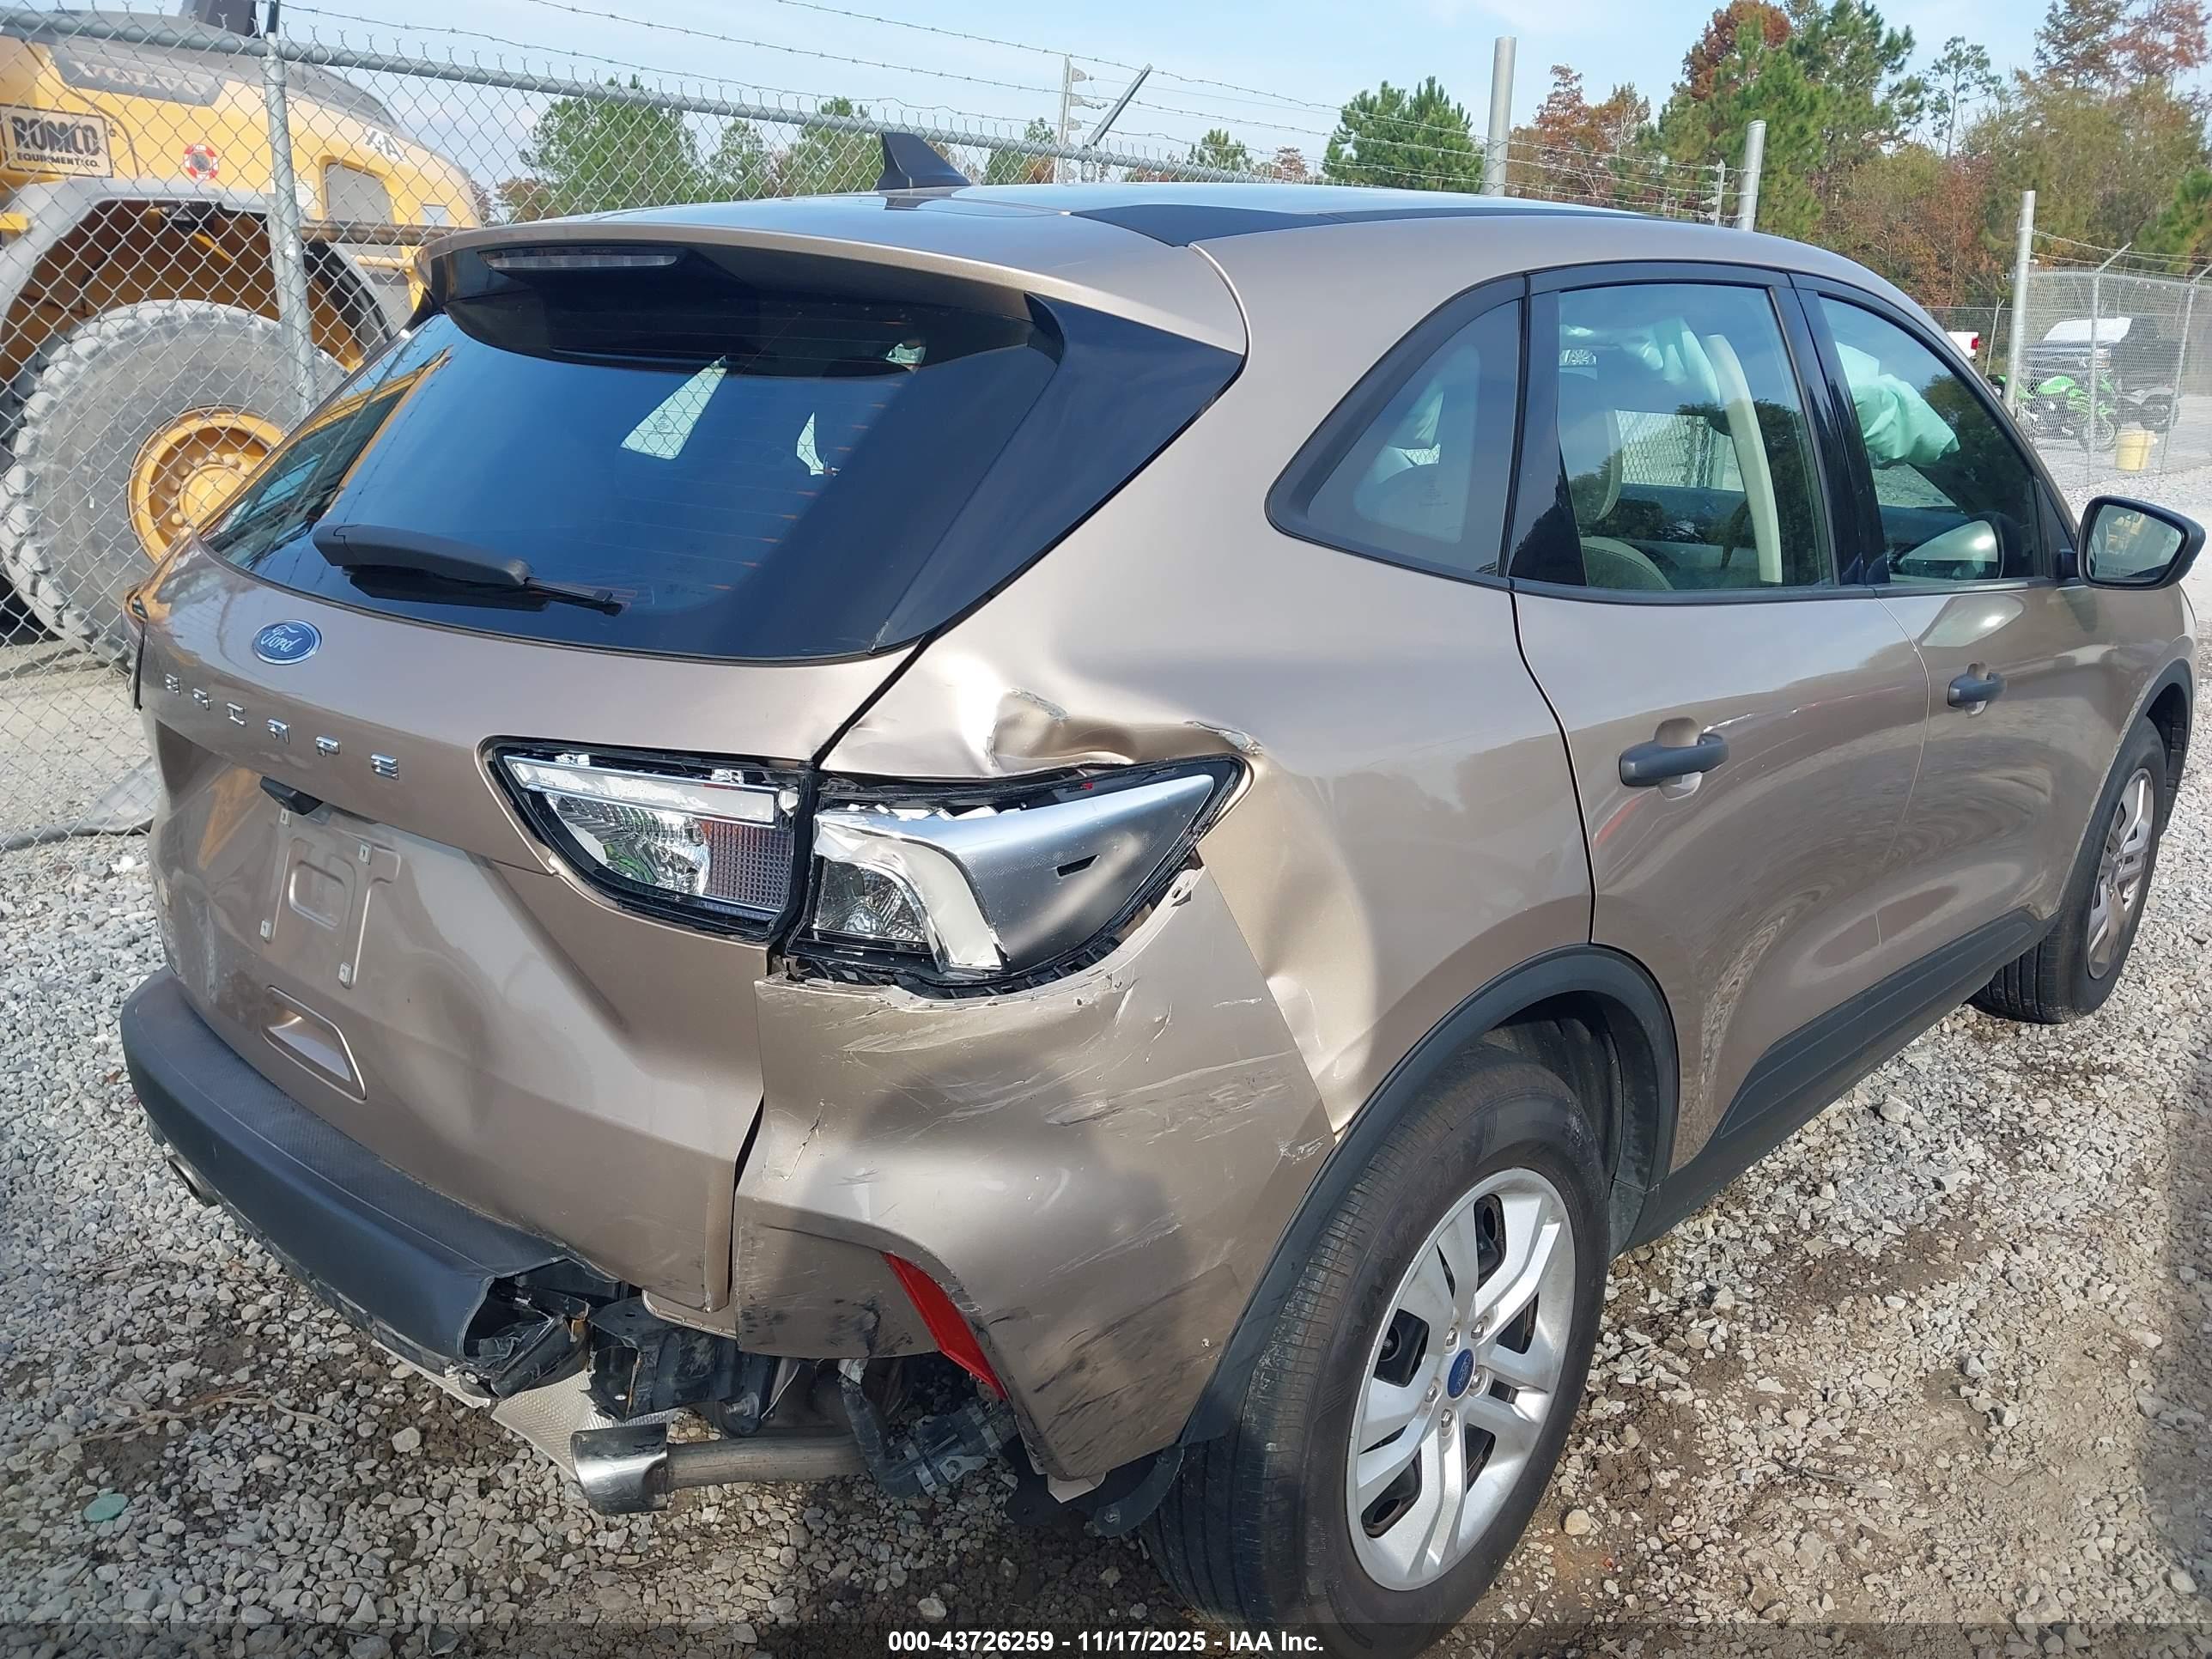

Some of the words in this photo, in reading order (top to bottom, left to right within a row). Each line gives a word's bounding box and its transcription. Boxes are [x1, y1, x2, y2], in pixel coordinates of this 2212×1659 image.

[68, 59, 209, 96] VOLVO
[10, 116, 100, 156] ROMCO
[259, 624, 304, 653] Ford
[164, 673, 399, 781] ESCAPE
